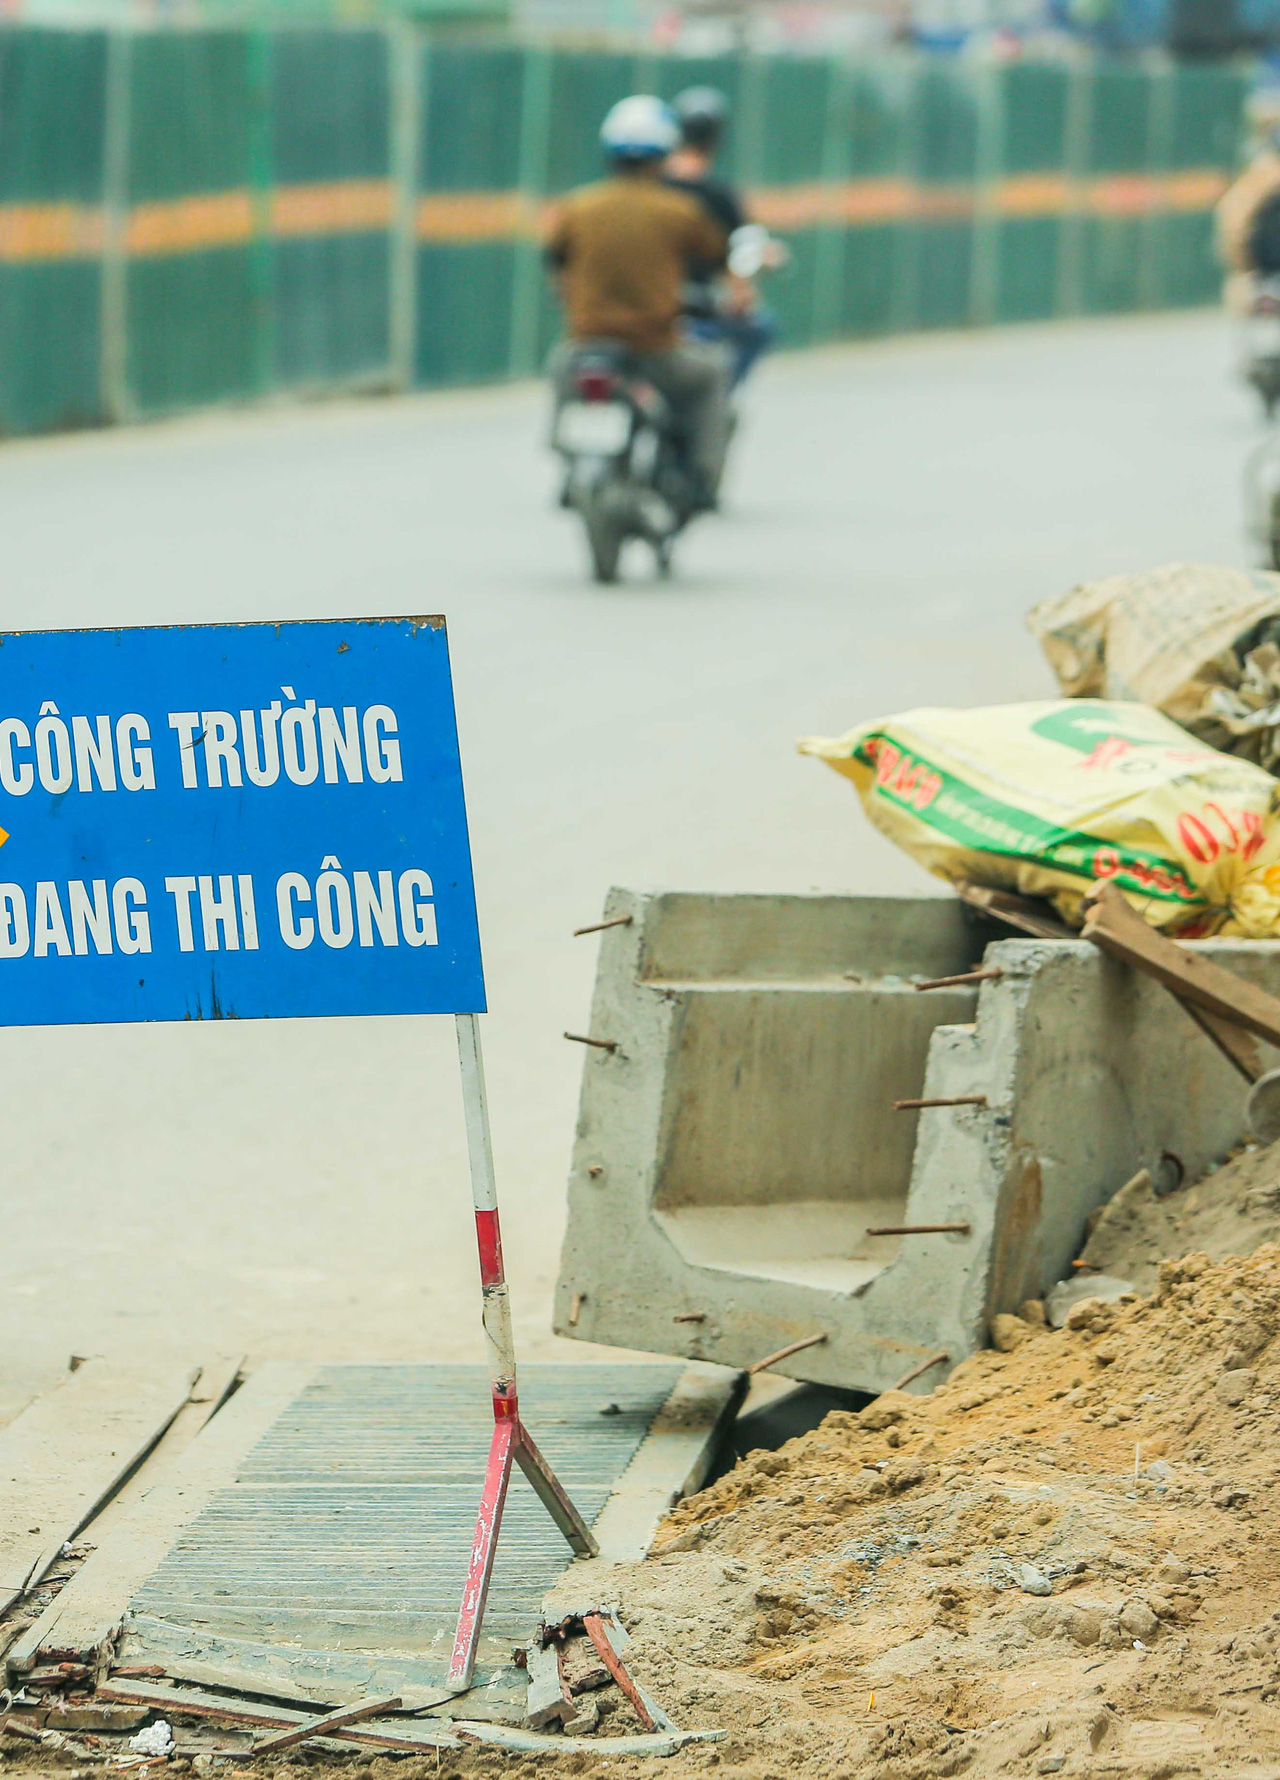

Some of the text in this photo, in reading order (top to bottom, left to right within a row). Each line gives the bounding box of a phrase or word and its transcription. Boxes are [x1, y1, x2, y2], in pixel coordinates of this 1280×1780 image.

[168, 686, 404, 789] TRƯỜNG
[165, 874, 260, 952] THI
[276, 855, 439, 950] CÔNG
